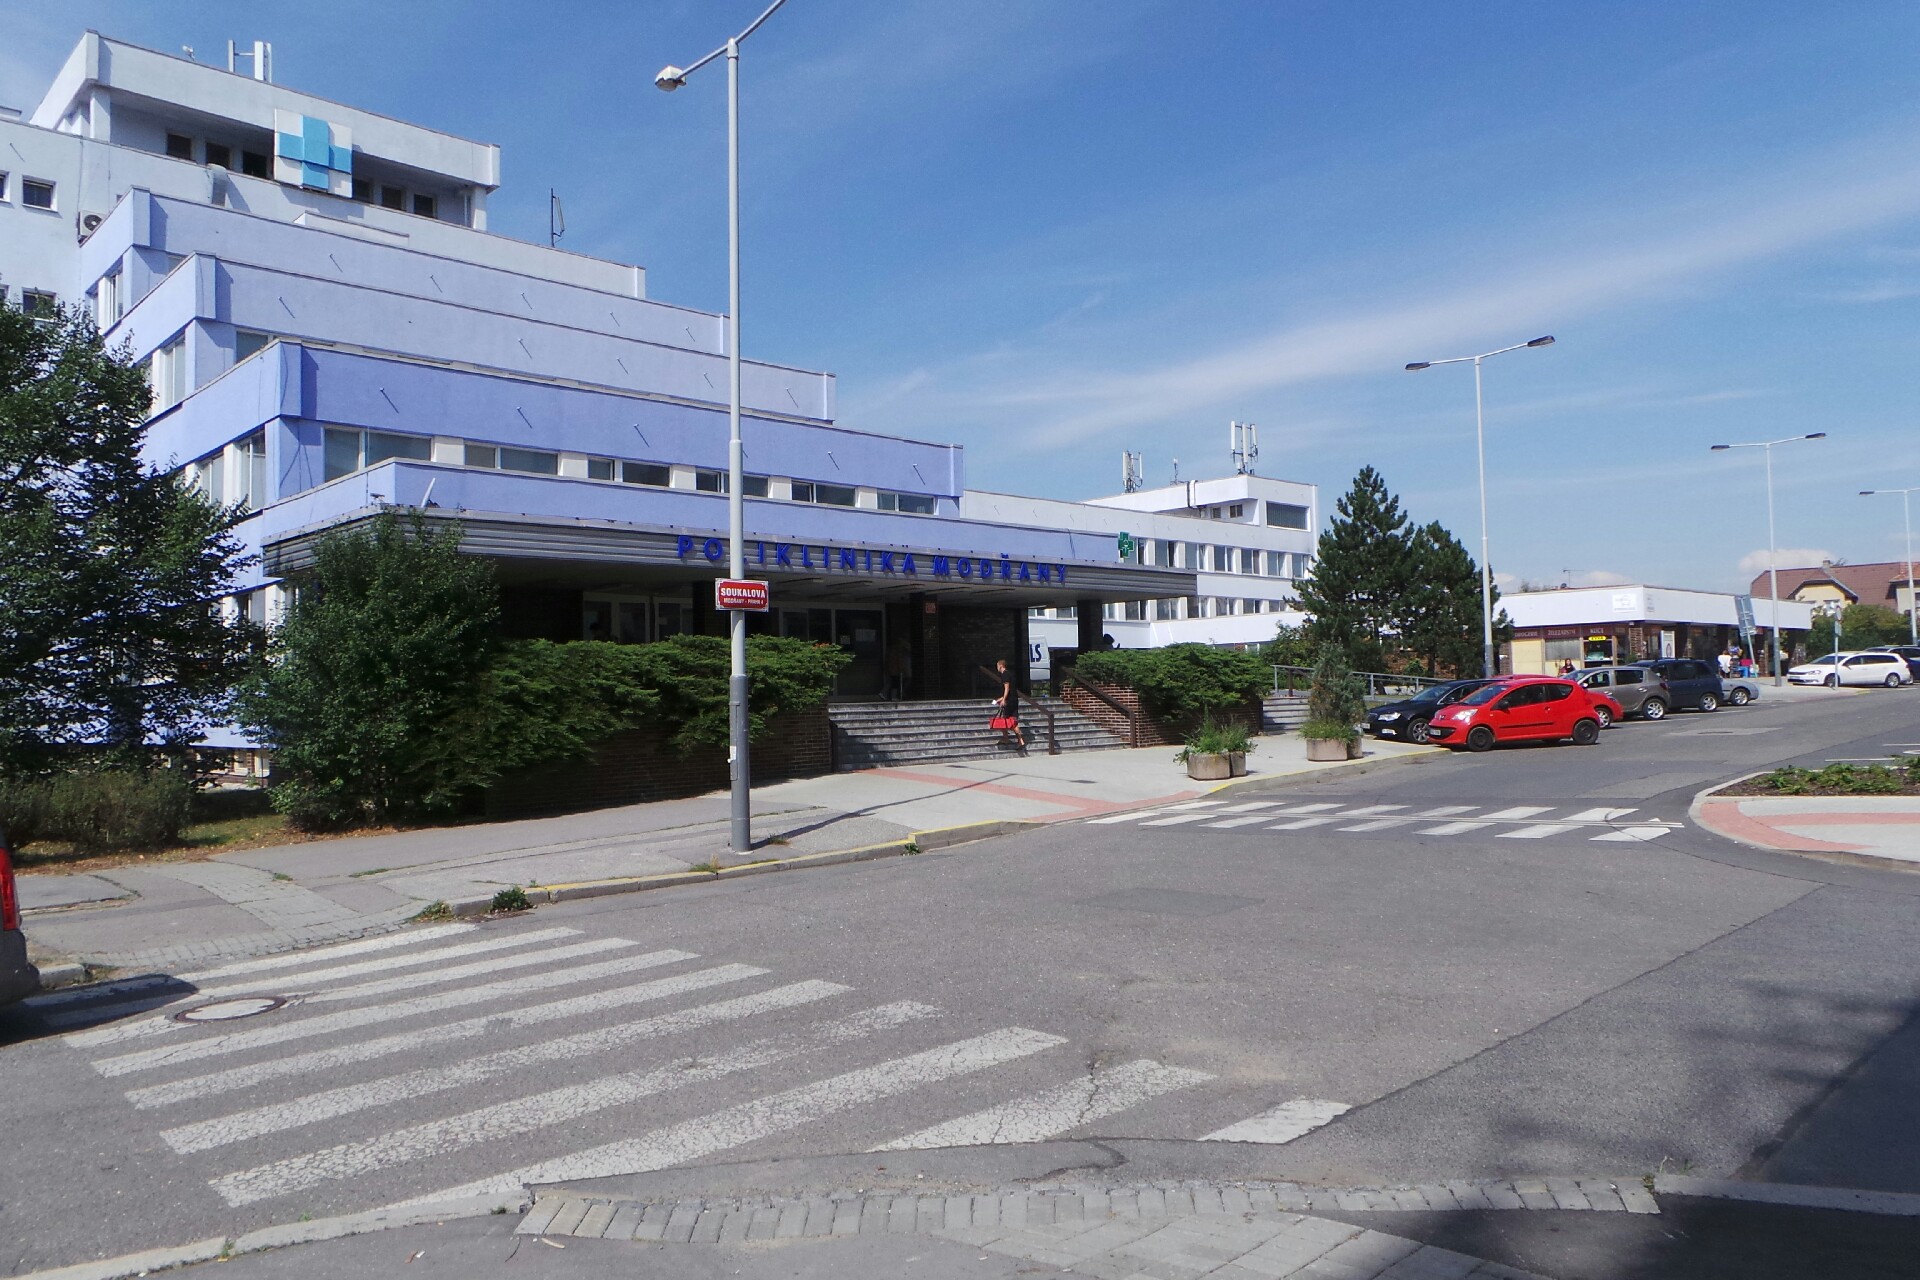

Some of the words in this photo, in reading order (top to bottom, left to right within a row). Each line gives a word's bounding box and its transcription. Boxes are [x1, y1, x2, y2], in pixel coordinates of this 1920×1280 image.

[678, 535, 917, 575] POIKLINIKA
[933, 552, 1067, 584] MODŘANY
[720, 588, 766, 598] SOUKALOVA
